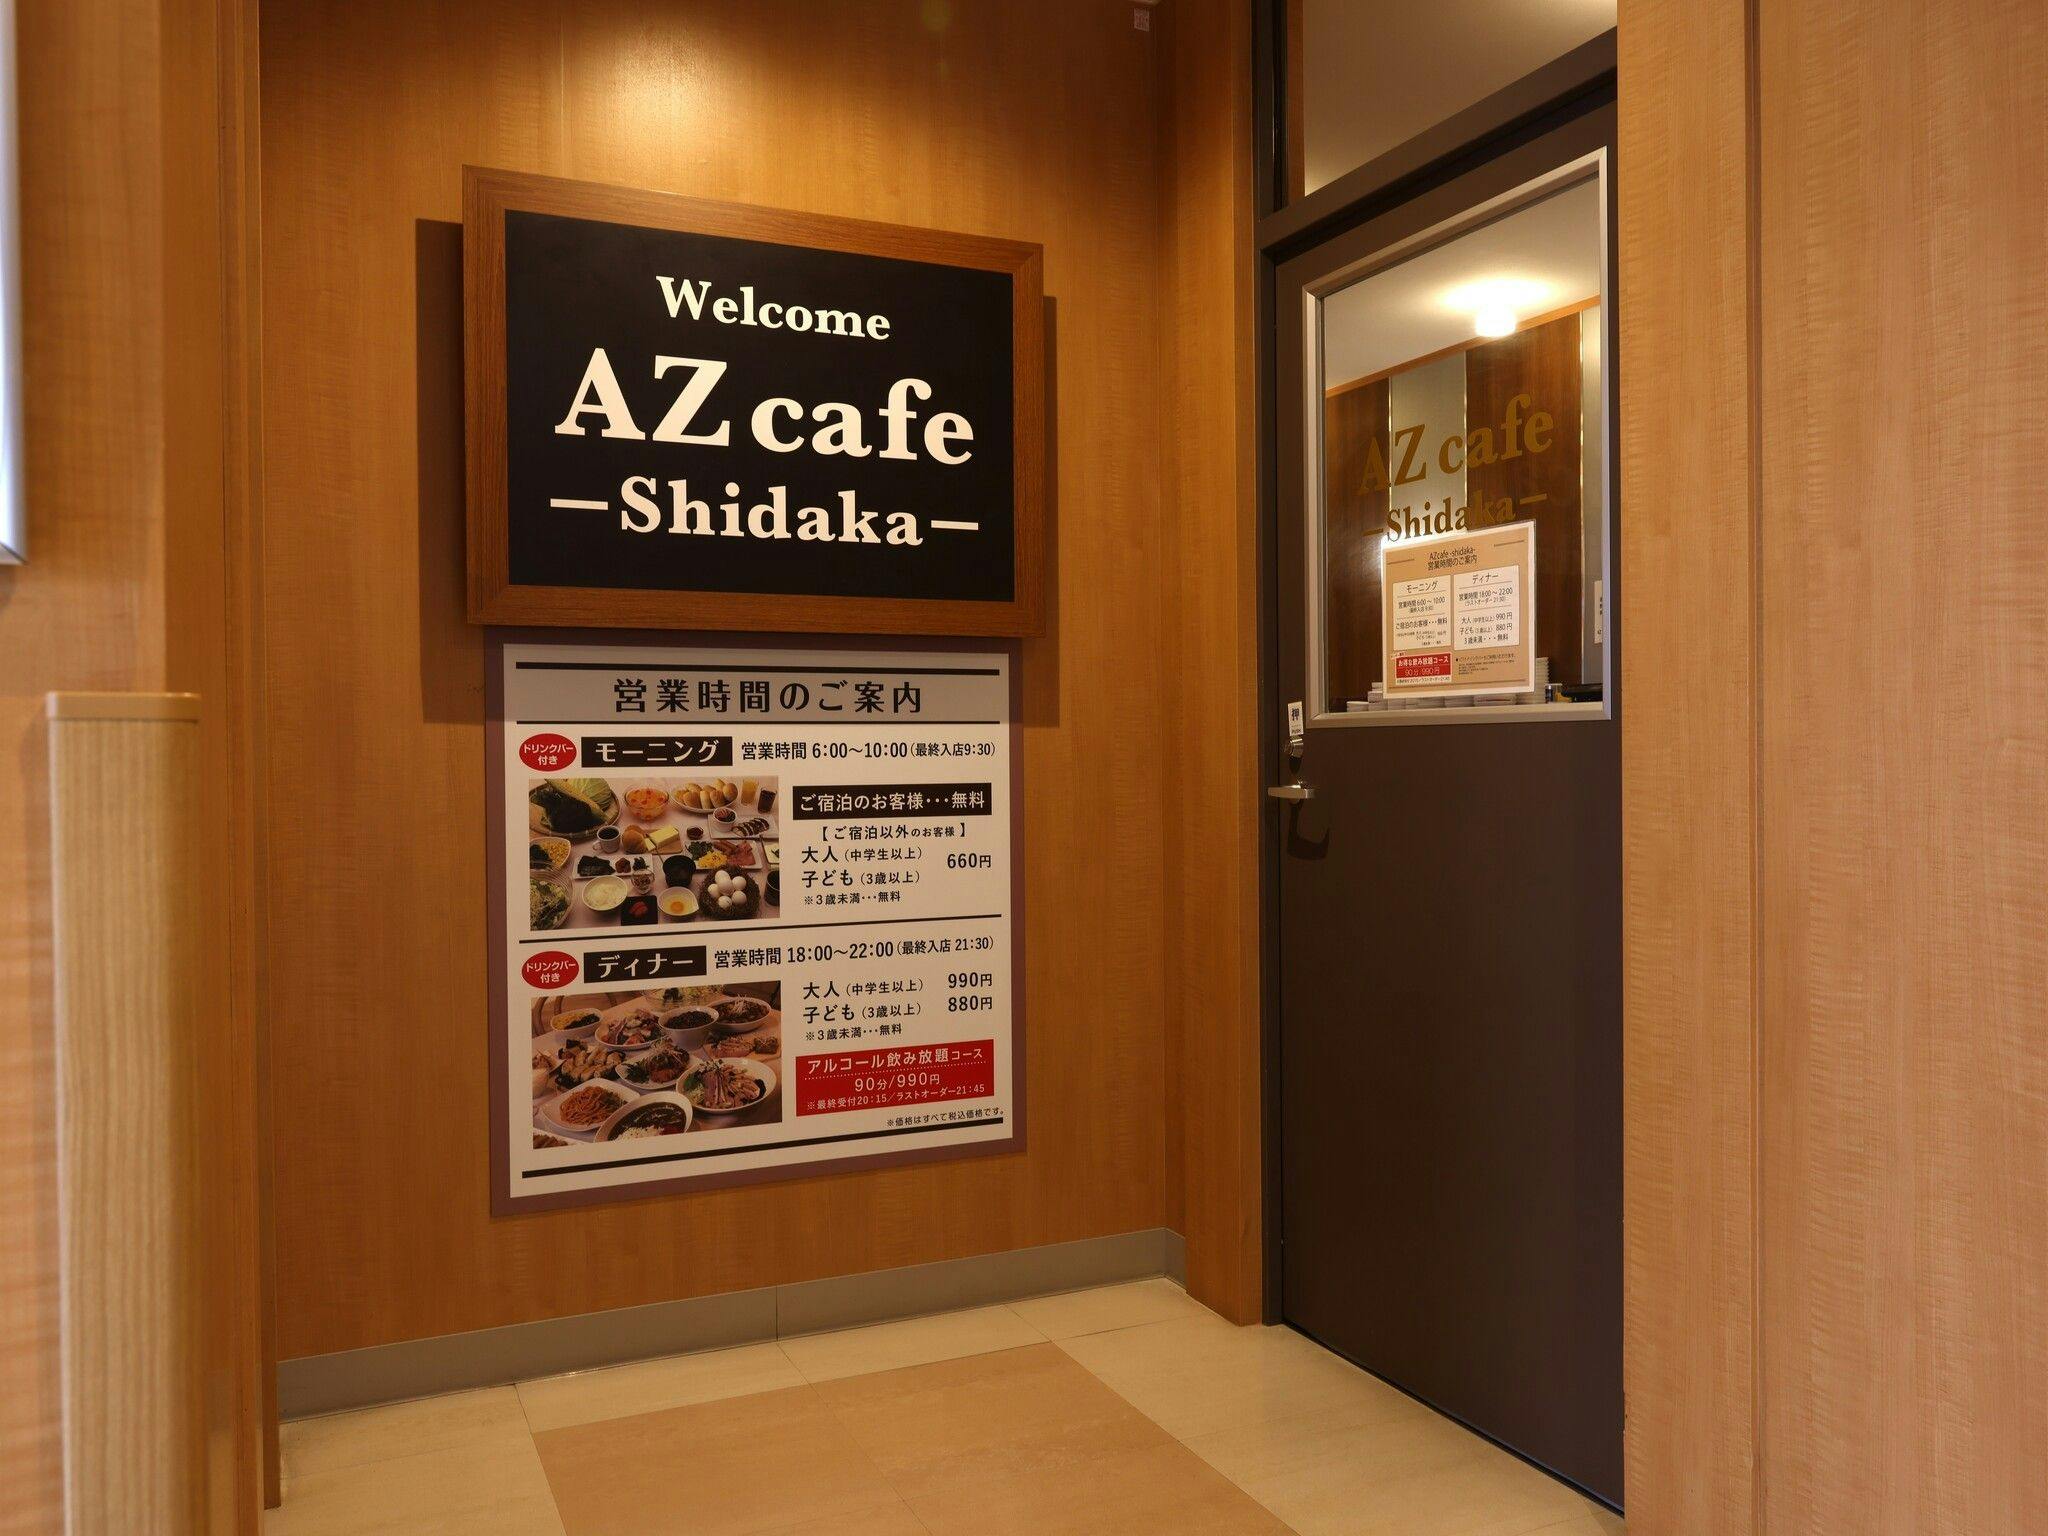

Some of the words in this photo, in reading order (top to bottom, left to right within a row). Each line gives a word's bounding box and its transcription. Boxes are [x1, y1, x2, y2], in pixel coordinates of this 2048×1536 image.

[656, 275, 891, 340] Welcome
[555, 347, 731, 447] AZ
[751, 378, 975, 465] cafe
[1357, 423, 1427, 496] AZ
[1438, 393, 1554, 475] cafe
[613, 678, 922, 714] 営業時間のご案内
[523, 743, 574, 754] ドリンクバー
[595, 739, 720, 763] モーニング
[741, 741, 807, 760] 営業時間
[537, 755, 558, 766] 付き
[801, 845, 839, 864] 大人
[947, 853, 992, 869] 660円
[801, 870, 854, 888] 子ども
[526, 960, 576, 972] ドリンクバー
[598, 953, 694, 979] ディナー
[714, 947, 781, 969] 営業時間
[540, 973, 561, 984] 付き
[803, 980, 840, 999] 大人
[947, 972, 993, 988] 990円
[803, 1003, 855, 1024] 子ども
[947, 996, 993, 1012] 880円
[807, 1047, 983, 1075] アルコール飲み放題コース
